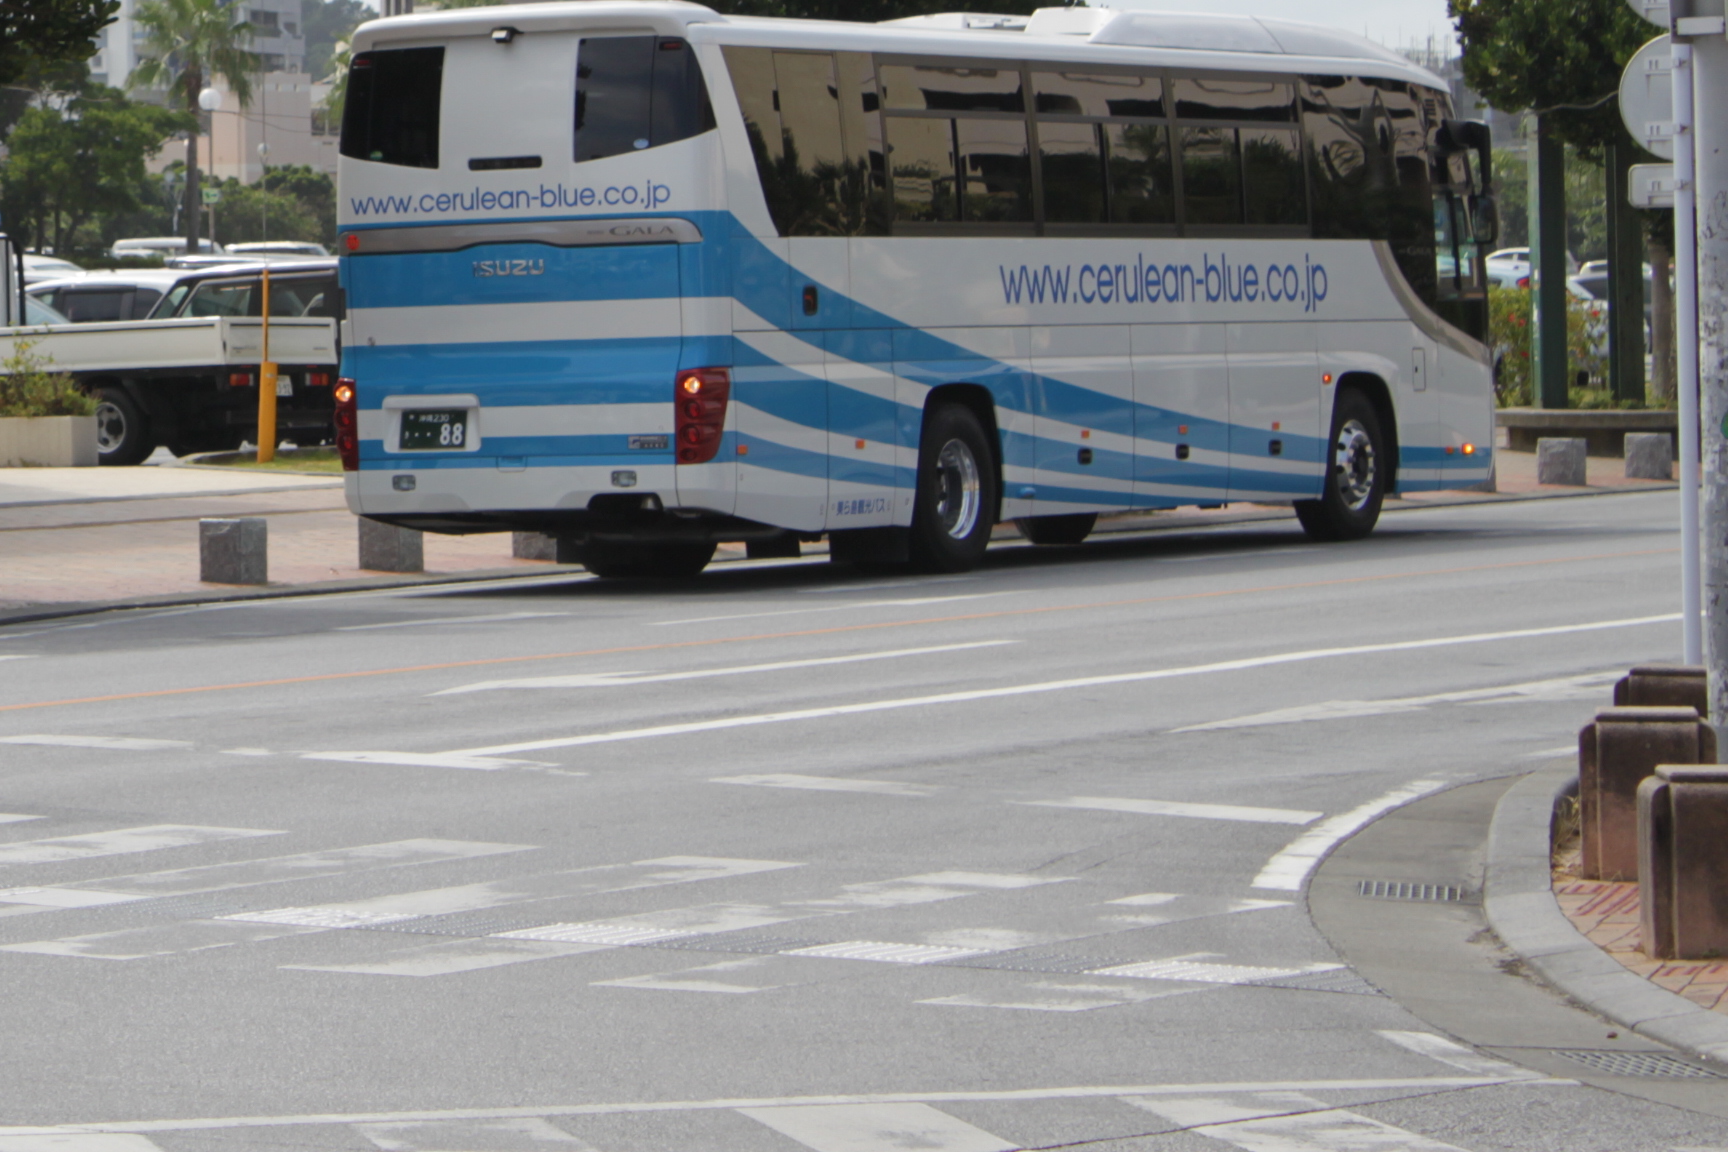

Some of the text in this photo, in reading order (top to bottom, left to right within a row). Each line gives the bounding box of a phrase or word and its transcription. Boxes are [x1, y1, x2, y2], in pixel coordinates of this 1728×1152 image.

[351, 179, 671, 215] www.cerulean-blue.co.jp
[609, 225, 674, 237] GALA
[472, 258, 545, 278] ISUZU
[999, 252, 1328, 313] www.cerulean-blue.co.jp
